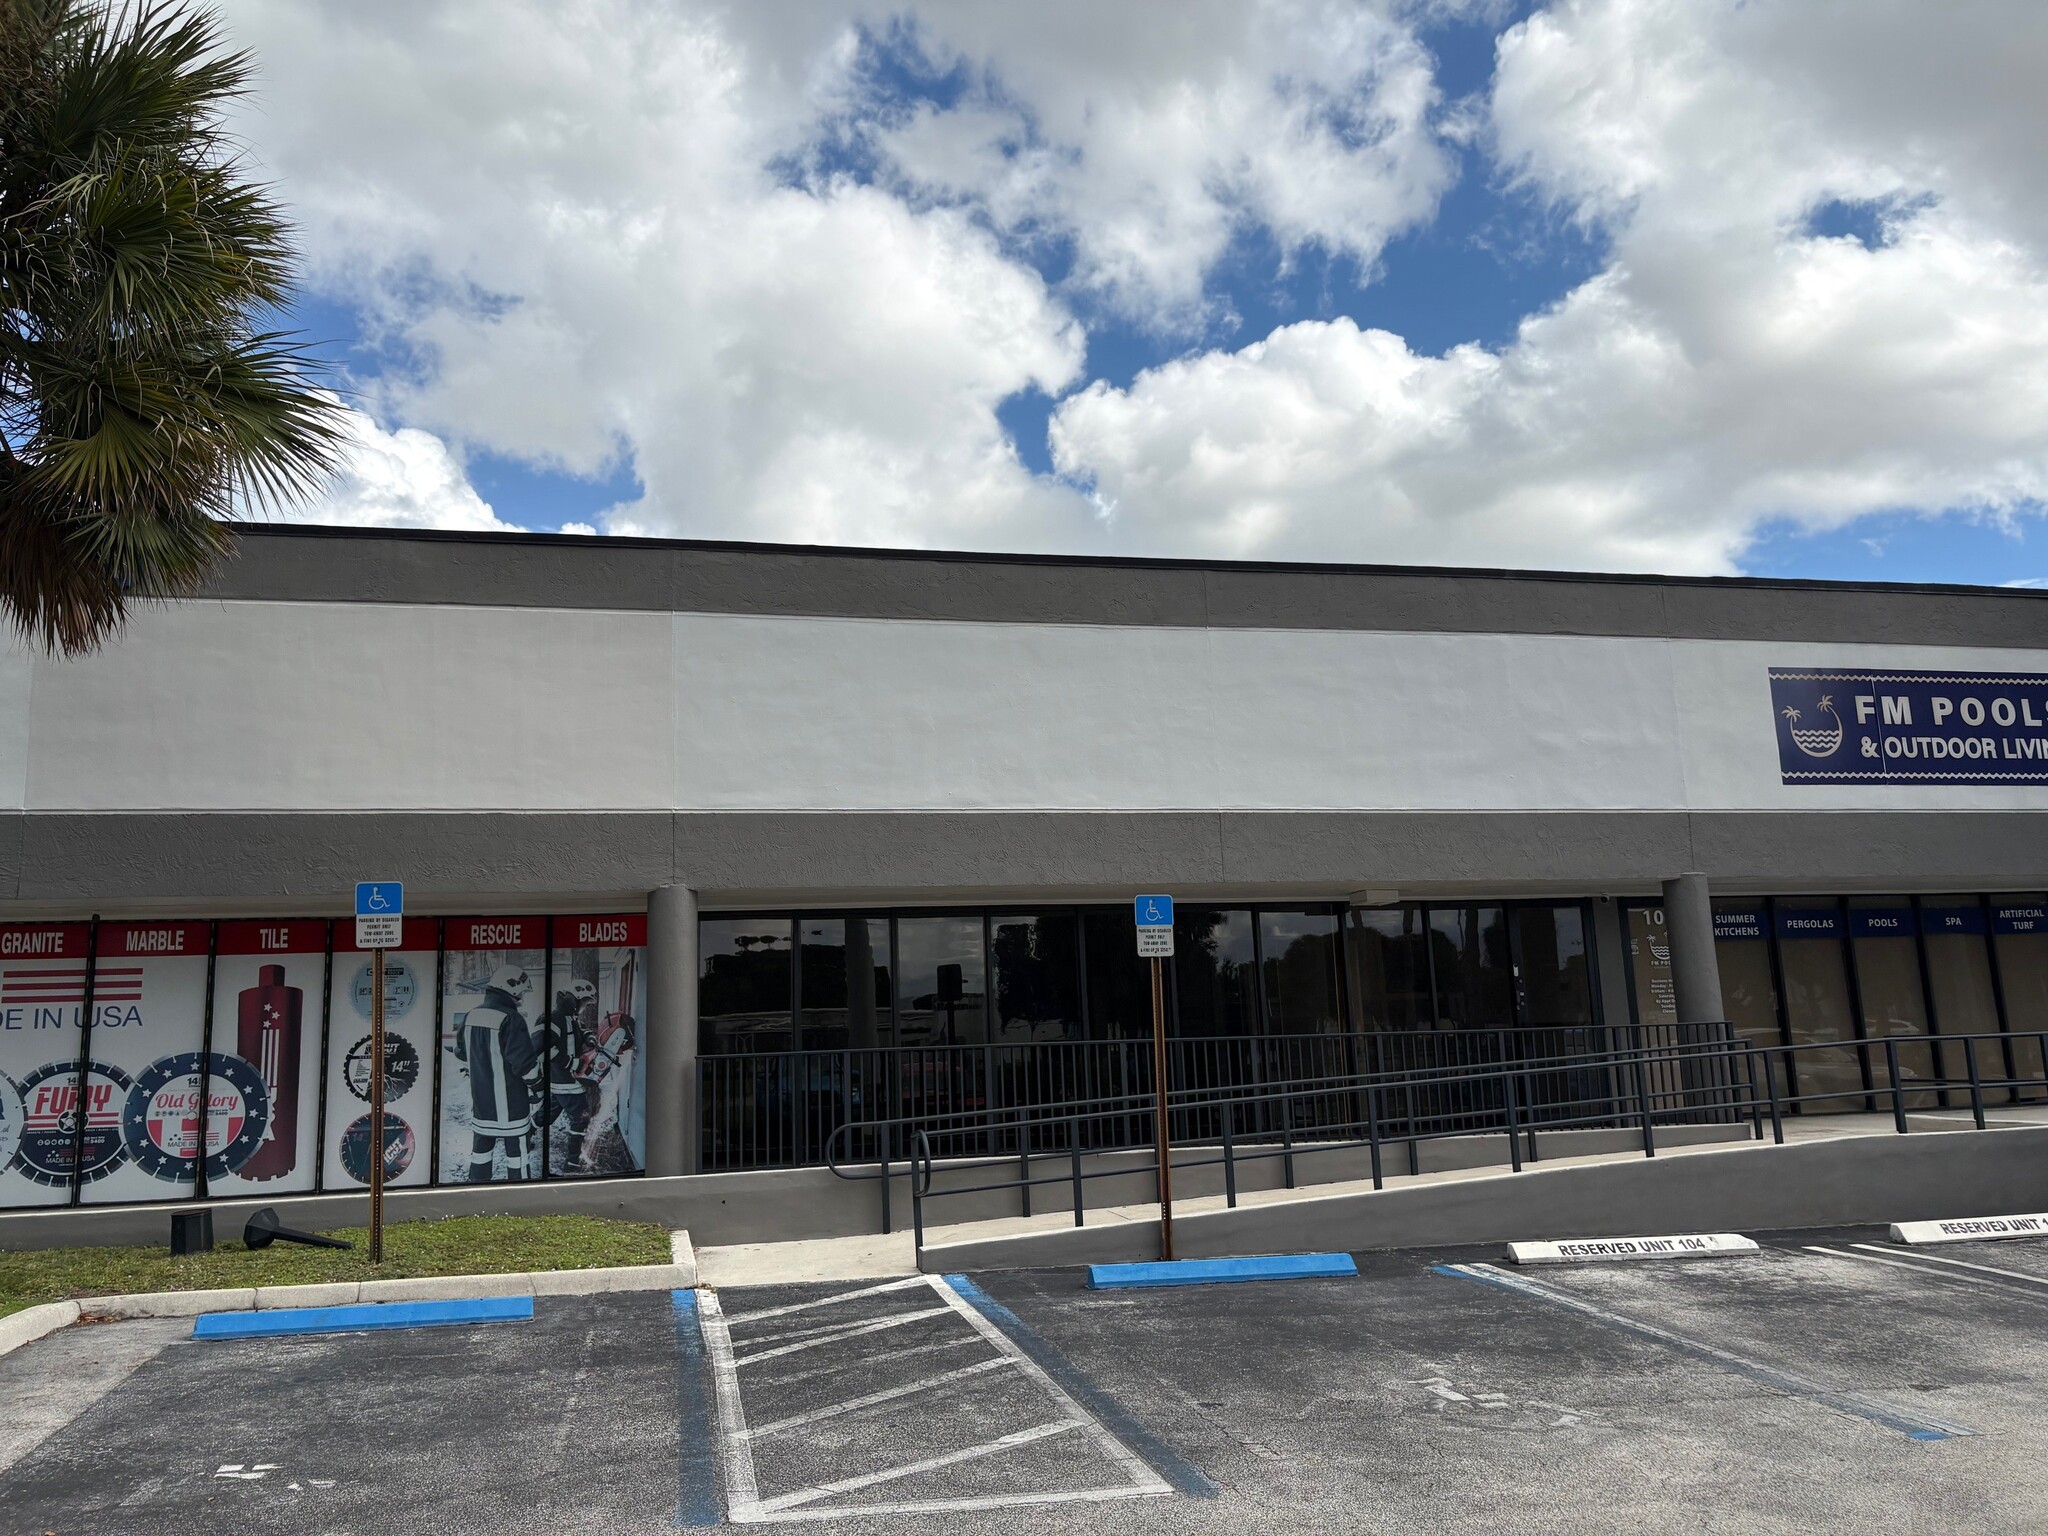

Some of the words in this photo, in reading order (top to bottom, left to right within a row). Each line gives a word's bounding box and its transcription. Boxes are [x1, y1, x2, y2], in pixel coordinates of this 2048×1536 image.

[1854, 696, 1912, 725] FM
[1931, 696, 2048, 727] POOL
[1860, 736, 1880, 758] &
[1884, 737, 1998, 759] OUTDOOR
[1715, 914, 1756, 924] SUMMER
[1868, 918, 1898, 927] POOLS
[1945, 918, 1962, 926] SPA
[2000, 910, 2044, 918] ARTIFICIAL
[579, 922, 627, 942] BLADES
[1714, 927, 1759, 936] KITCHENS
[1787, 920, 1834, 928] PERGOLAS
[2012, 922, 2034, 930] TURF
[1, 932, 64, 953] GRANITE
[126, 930, 184, 951] MARBLE
[260, 928, 288, 949] TILE
[471, 924, 521, 945] RESCUE
[34, 1008, 62, 1029] IN
[74, 1005, 142, 1028] USA
[34, 1084, 112, 1114] FURY
[155, 1093, 184, 1108] Old
[188, 1092, 238, 1111] Glory
[1940, 1220, 2008, 1234] RESERVED
[2008, 1218, 2040, 1231] UNIT
[1558, 1242, 1637, 1256] RESERVED
[1638, 1240, 1675, 1252] UNIT
[1678, 1238, 1706, 1250] 104
